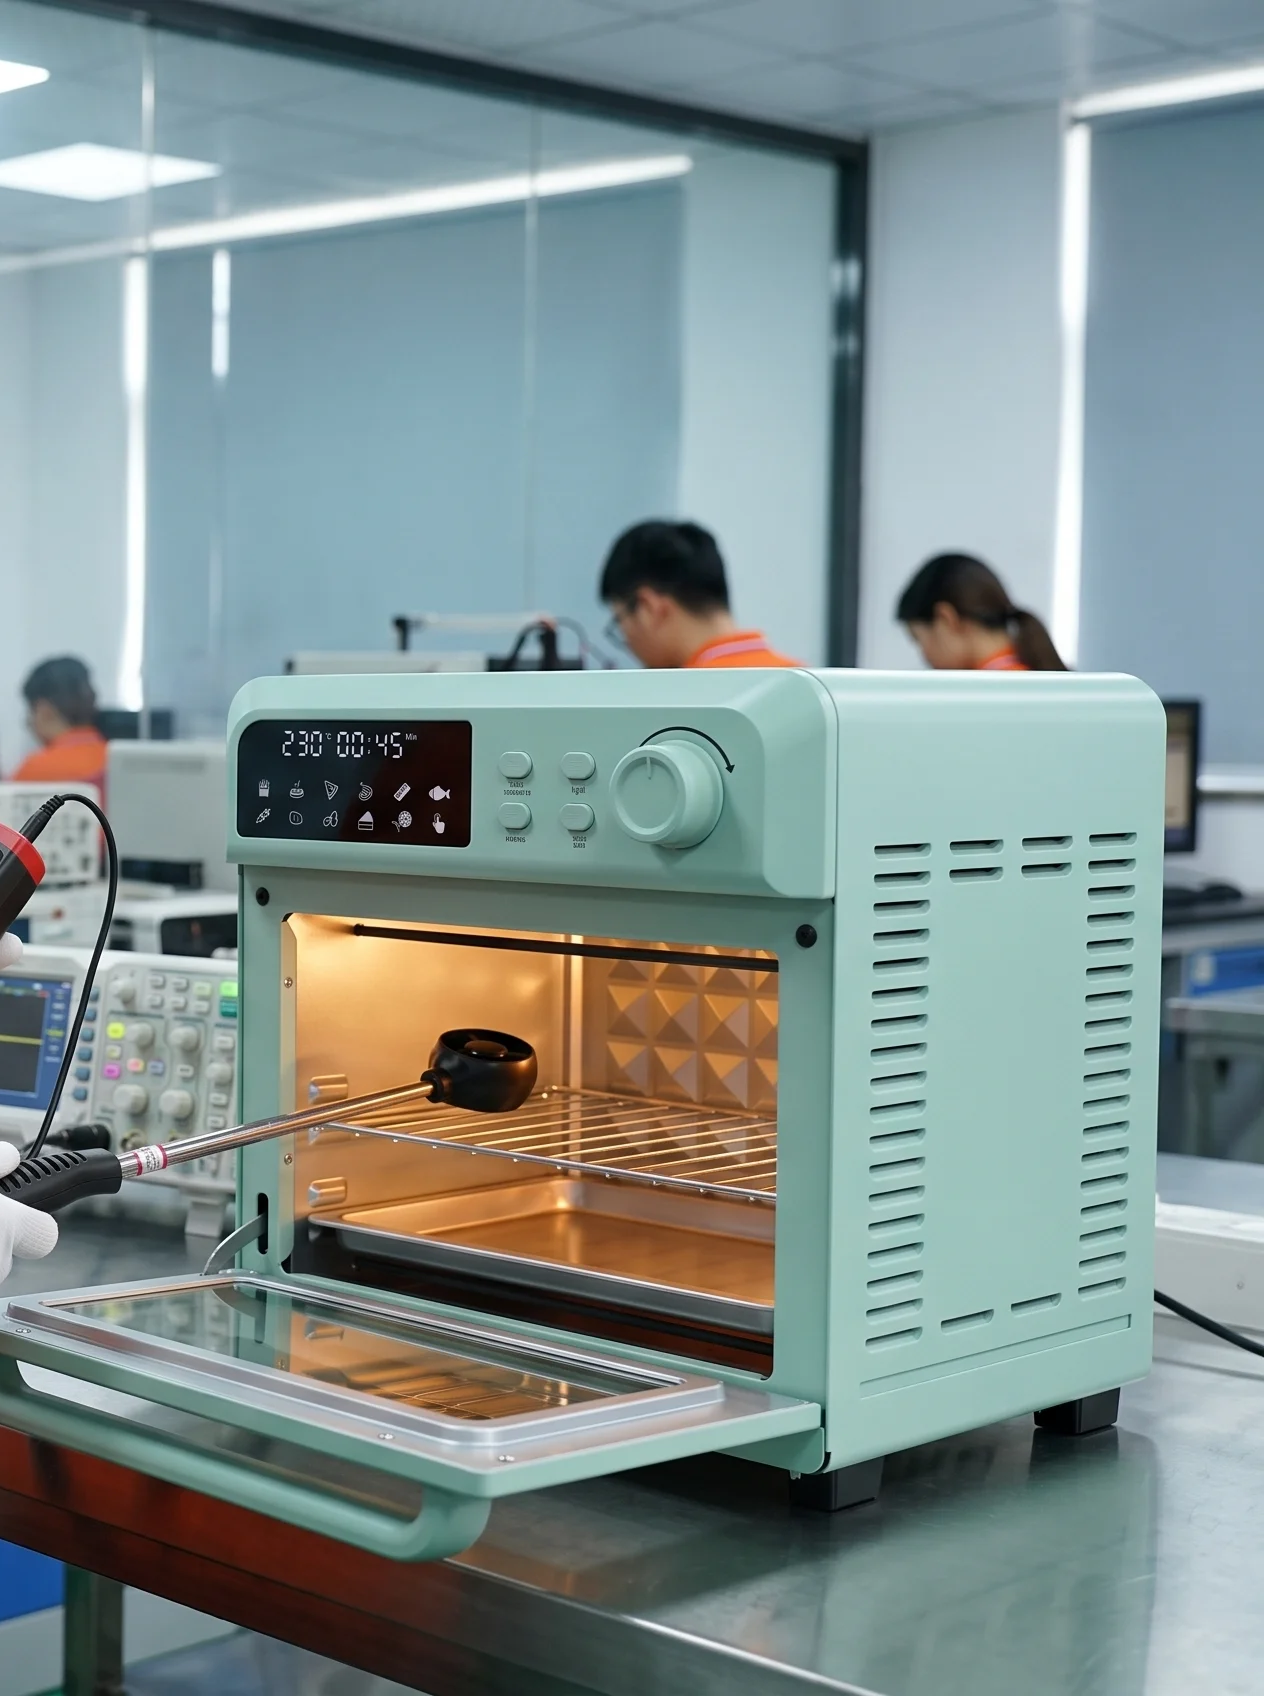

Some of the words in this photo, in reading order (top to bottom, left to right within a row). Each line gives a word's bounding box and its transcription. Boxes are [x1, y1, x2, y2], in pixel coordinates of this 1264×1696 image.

[282, 730, 323, 757] 230
[337, 731, 403, 759] 00:45
[405, 733, 418, 741] Min
